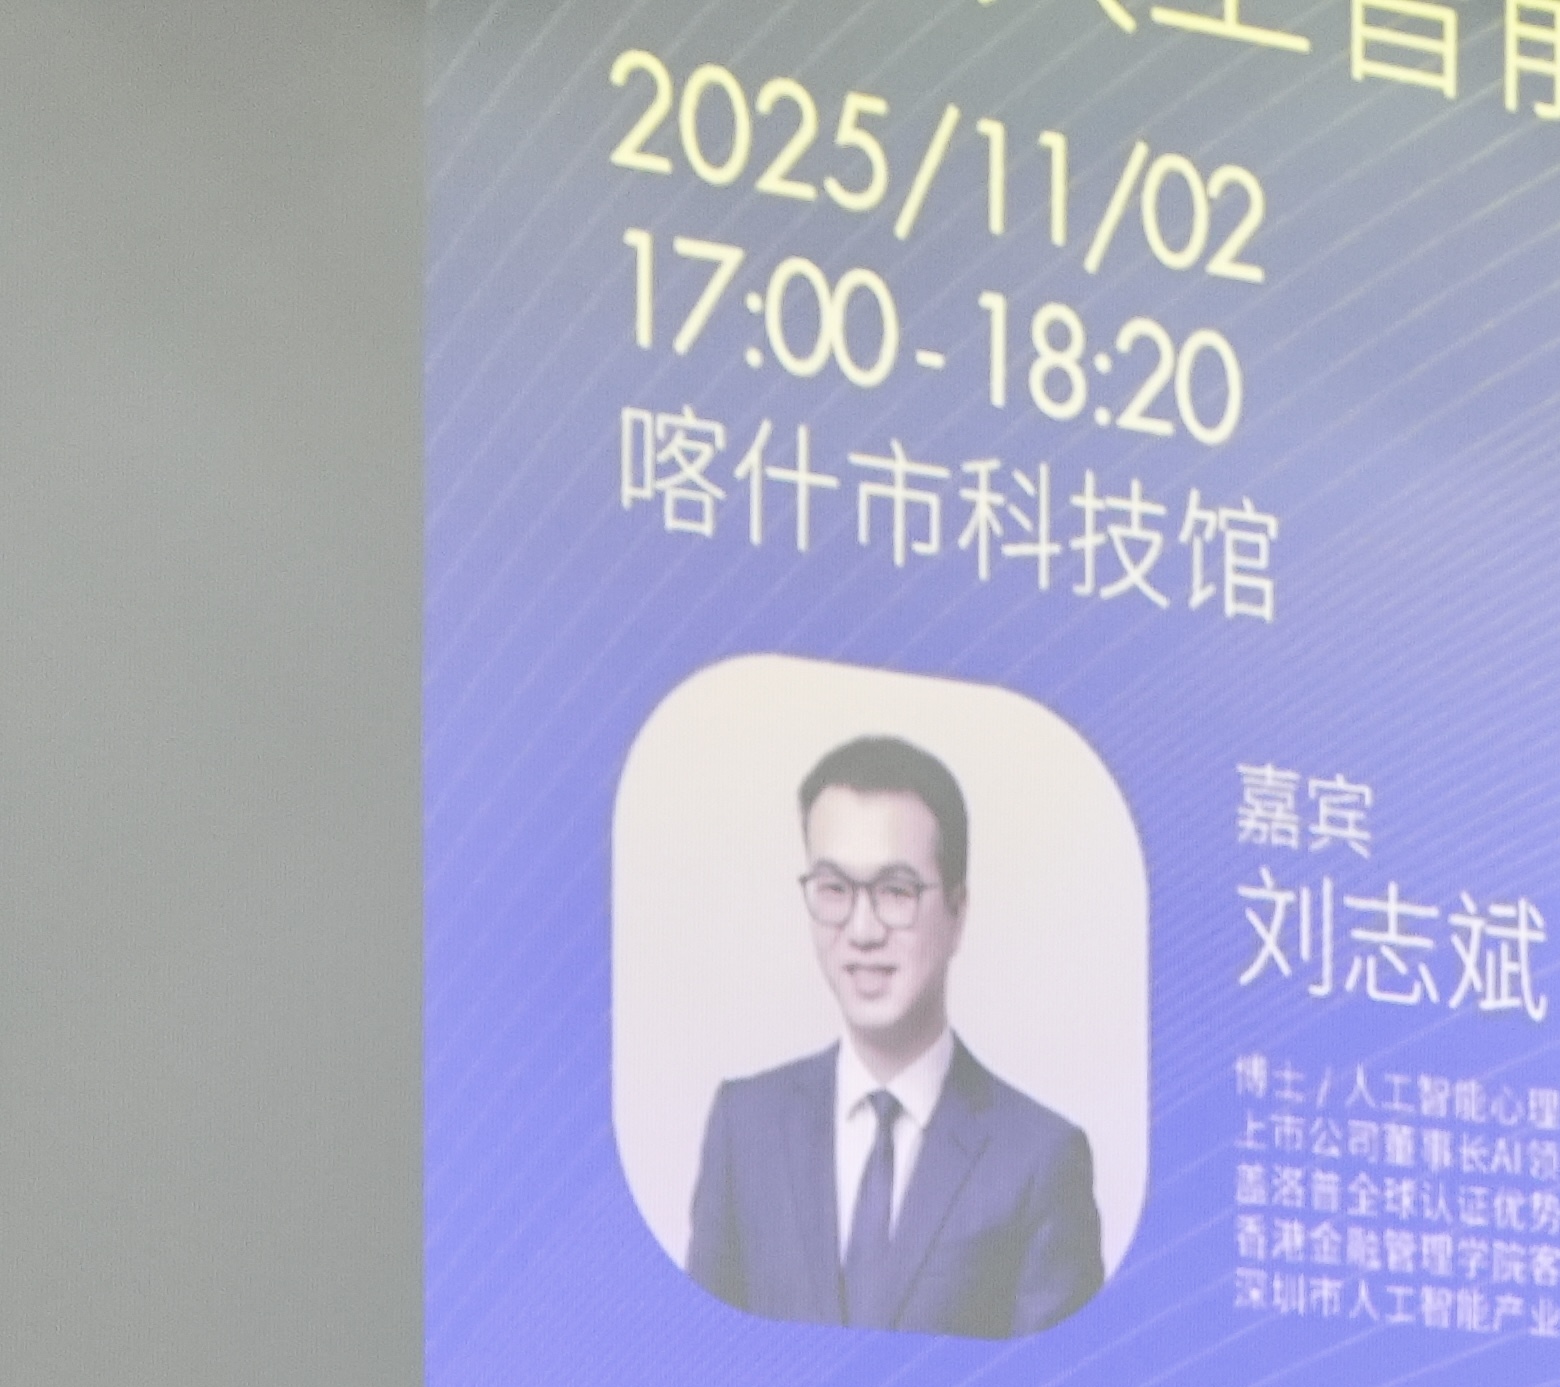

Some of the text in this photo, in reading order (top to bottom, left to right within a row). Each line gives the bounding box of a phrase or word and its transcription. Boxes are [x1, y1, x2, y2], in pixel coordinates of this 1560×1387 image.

[609, 50, 1265, 283] 2025/11/02
[620, 405, 1277, 622] 喀什市科技馆
[1235, 762, 1373, 858] 嘉宾
[1237, 866, 1548, 1022] 刘志斌
